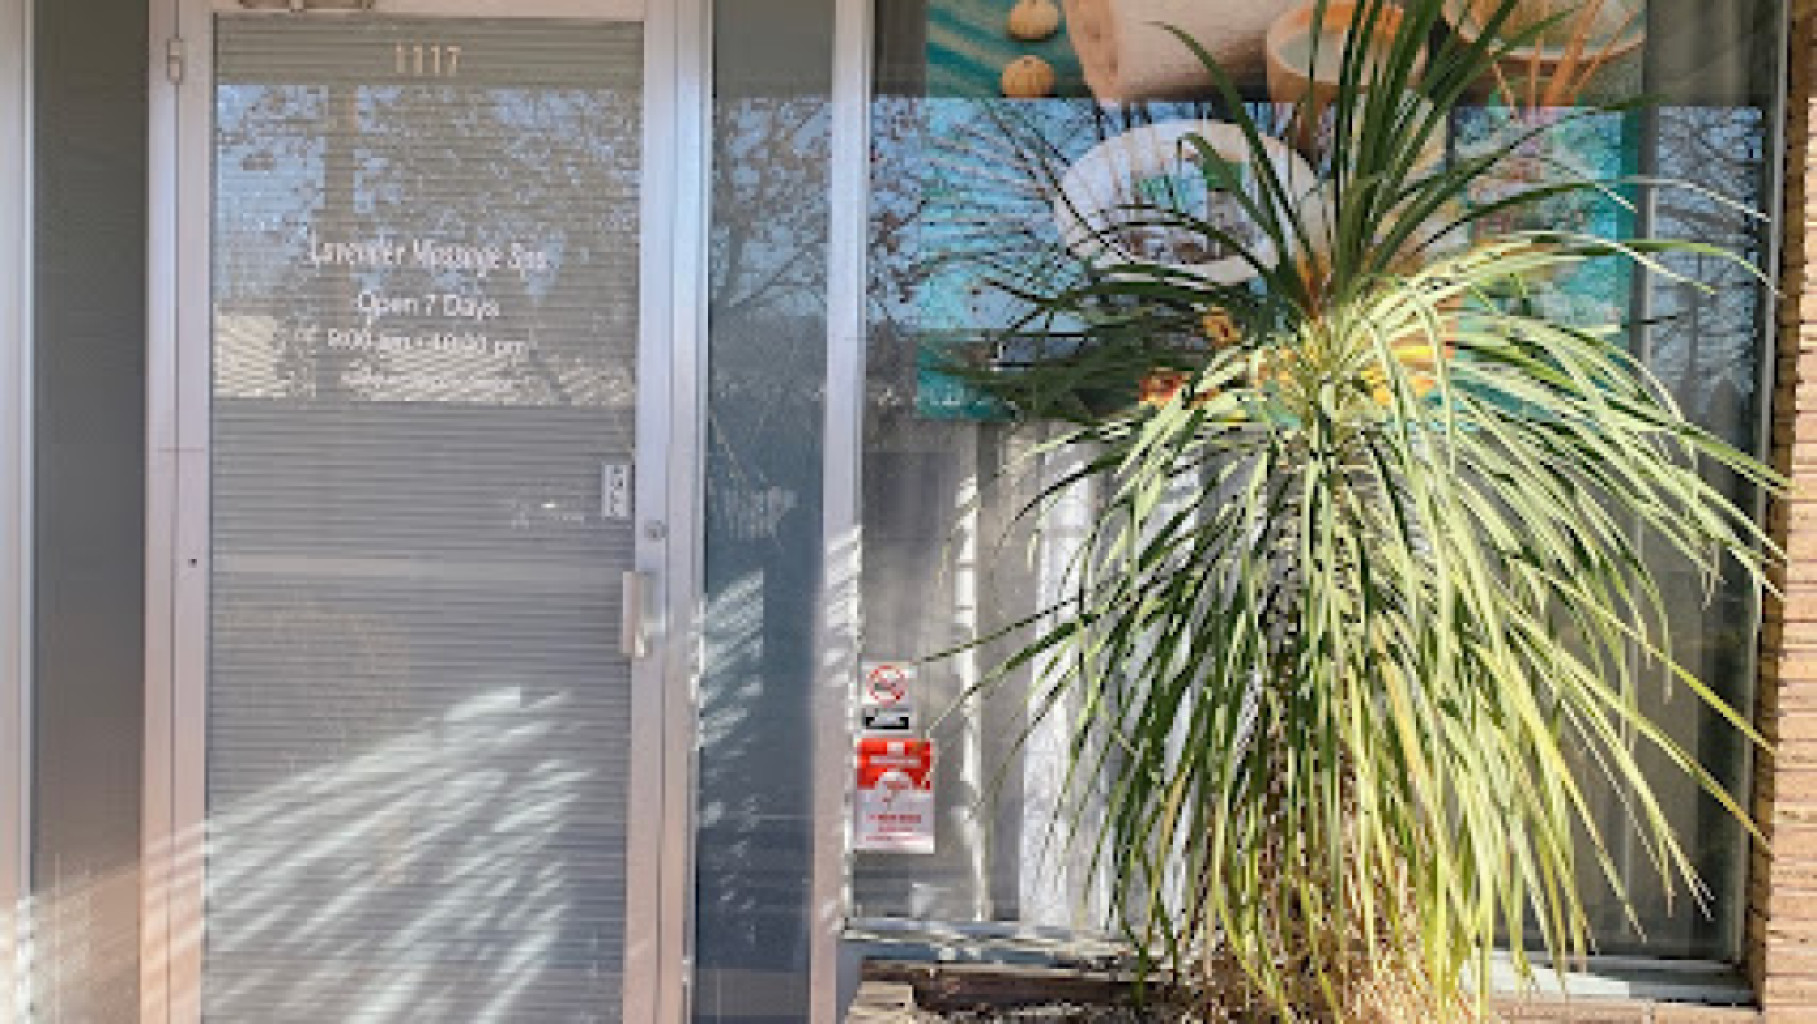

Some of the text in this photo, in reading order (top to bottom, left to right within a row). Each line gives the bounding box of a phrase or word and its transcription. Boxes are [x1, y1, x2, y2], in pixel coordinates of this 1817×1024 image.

[395, 40, 461, 76] 1117
[358, 290, 499, 325] Open 7 Days
